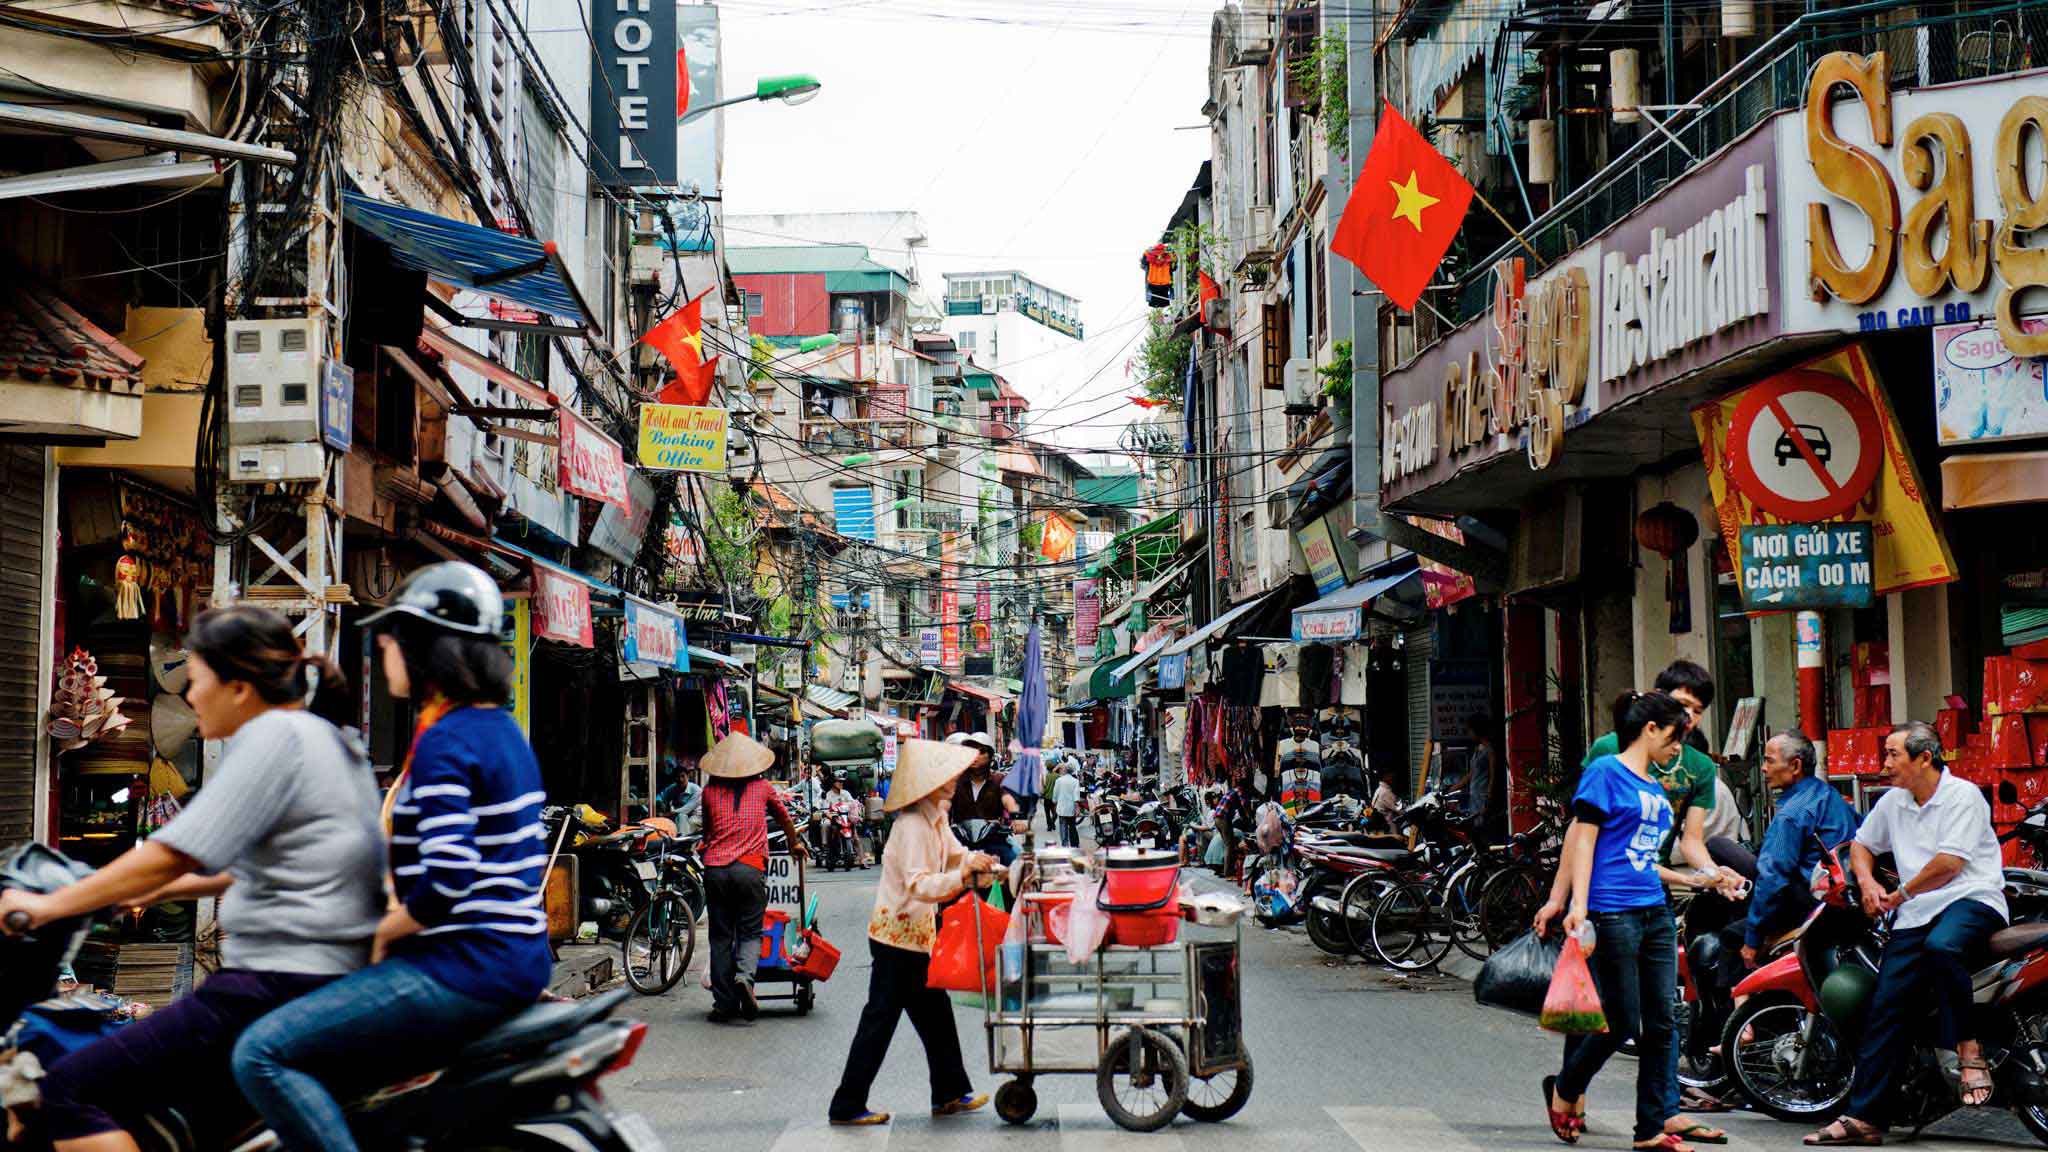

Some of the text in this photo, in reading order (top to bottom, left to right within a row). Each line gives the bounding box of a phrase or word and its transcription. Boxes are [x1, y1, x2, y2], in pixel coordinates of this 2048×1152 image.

[1602, 164, 1769, 386] Restaurant
[645, 407, 725, 432] Hotel and Travel
[649, 432, 715, 451] Booking
[657, 449, 704, 467] Office
[1752, 525, 1862, 558] NƠI GỬI XE
[1745, 560, 1801, 590] CÁCH
[1850, 561, 1871, 585] M
